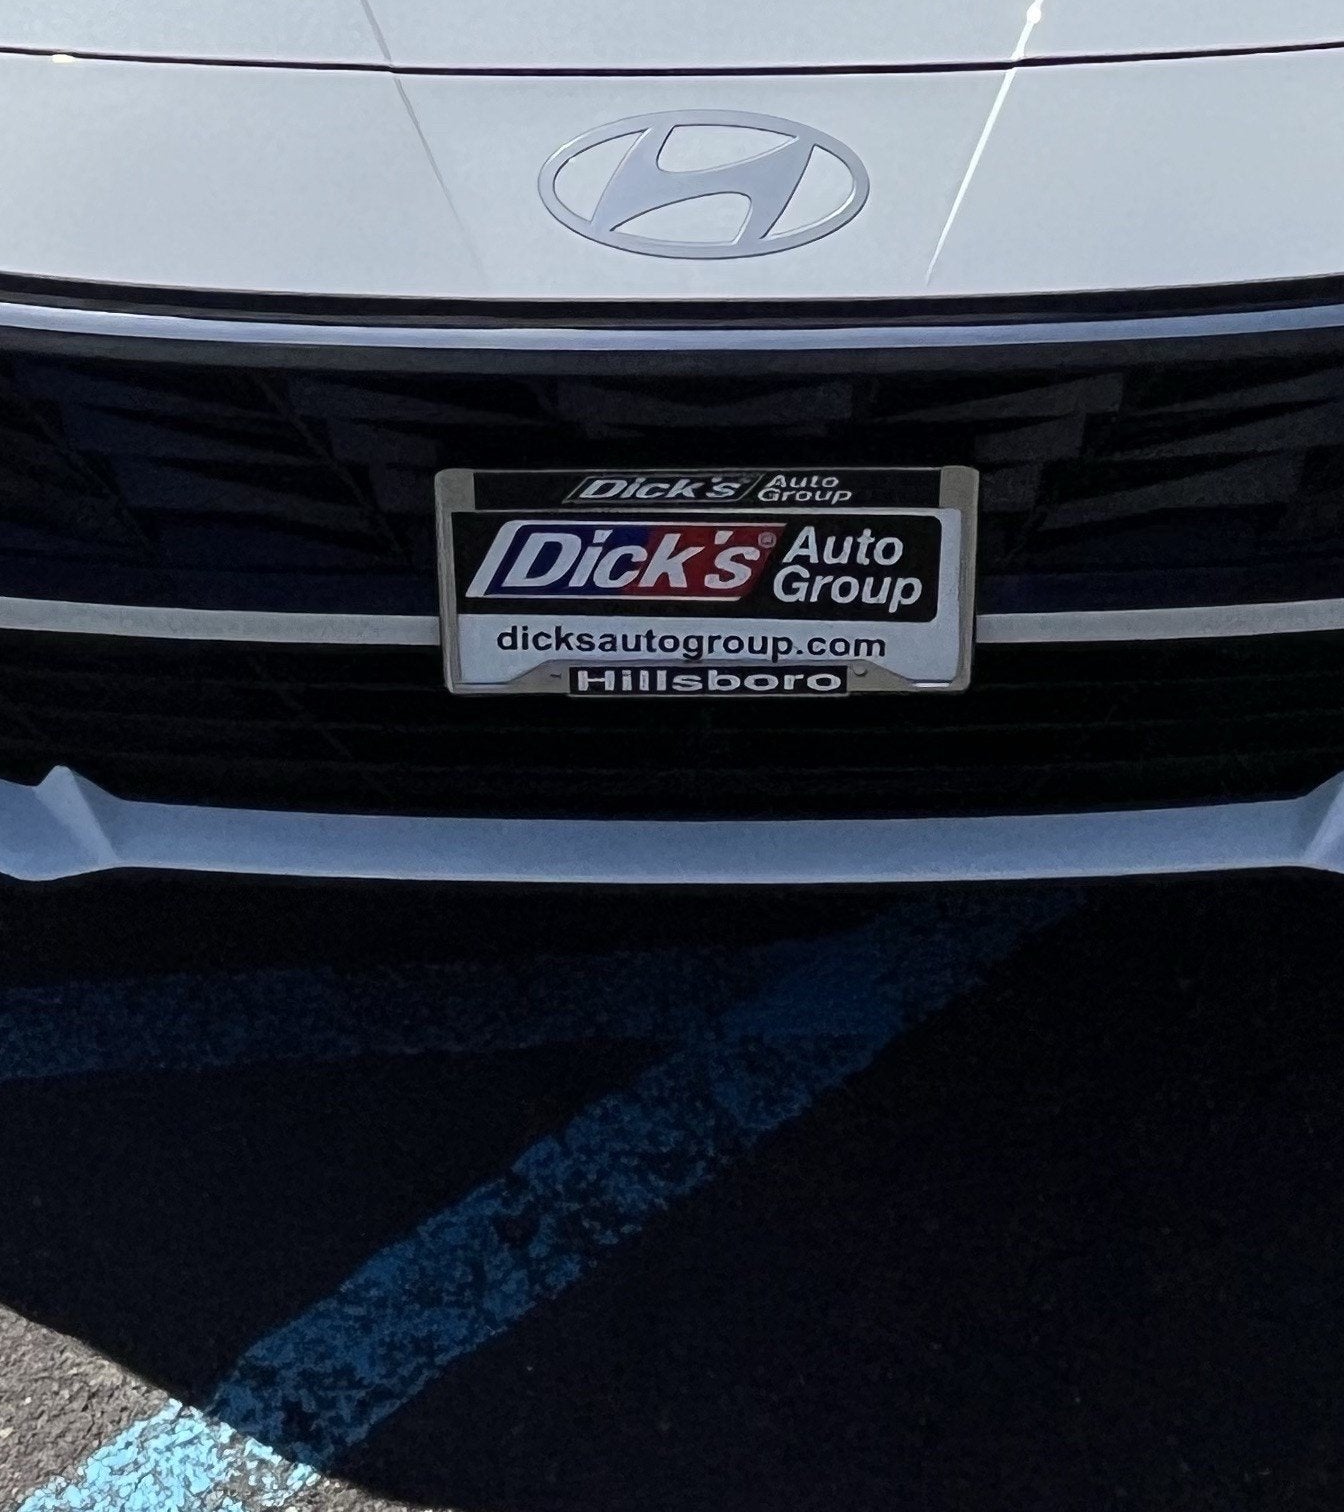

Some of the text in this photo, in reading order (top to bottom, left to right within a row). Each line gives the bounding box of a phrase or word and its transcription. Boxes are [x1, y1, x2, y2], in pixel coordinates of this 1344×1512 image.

[579, 474, 840, 500] Dick's Auto
[757, 488, 852, 505] Group
[501, 525, 904, 589] Dick's Auto
[773, 564, 923, 613] Group
[497, 625, 886, 662] dicksautogroup.com
[577, 668, 842, 692] Hillsboro
